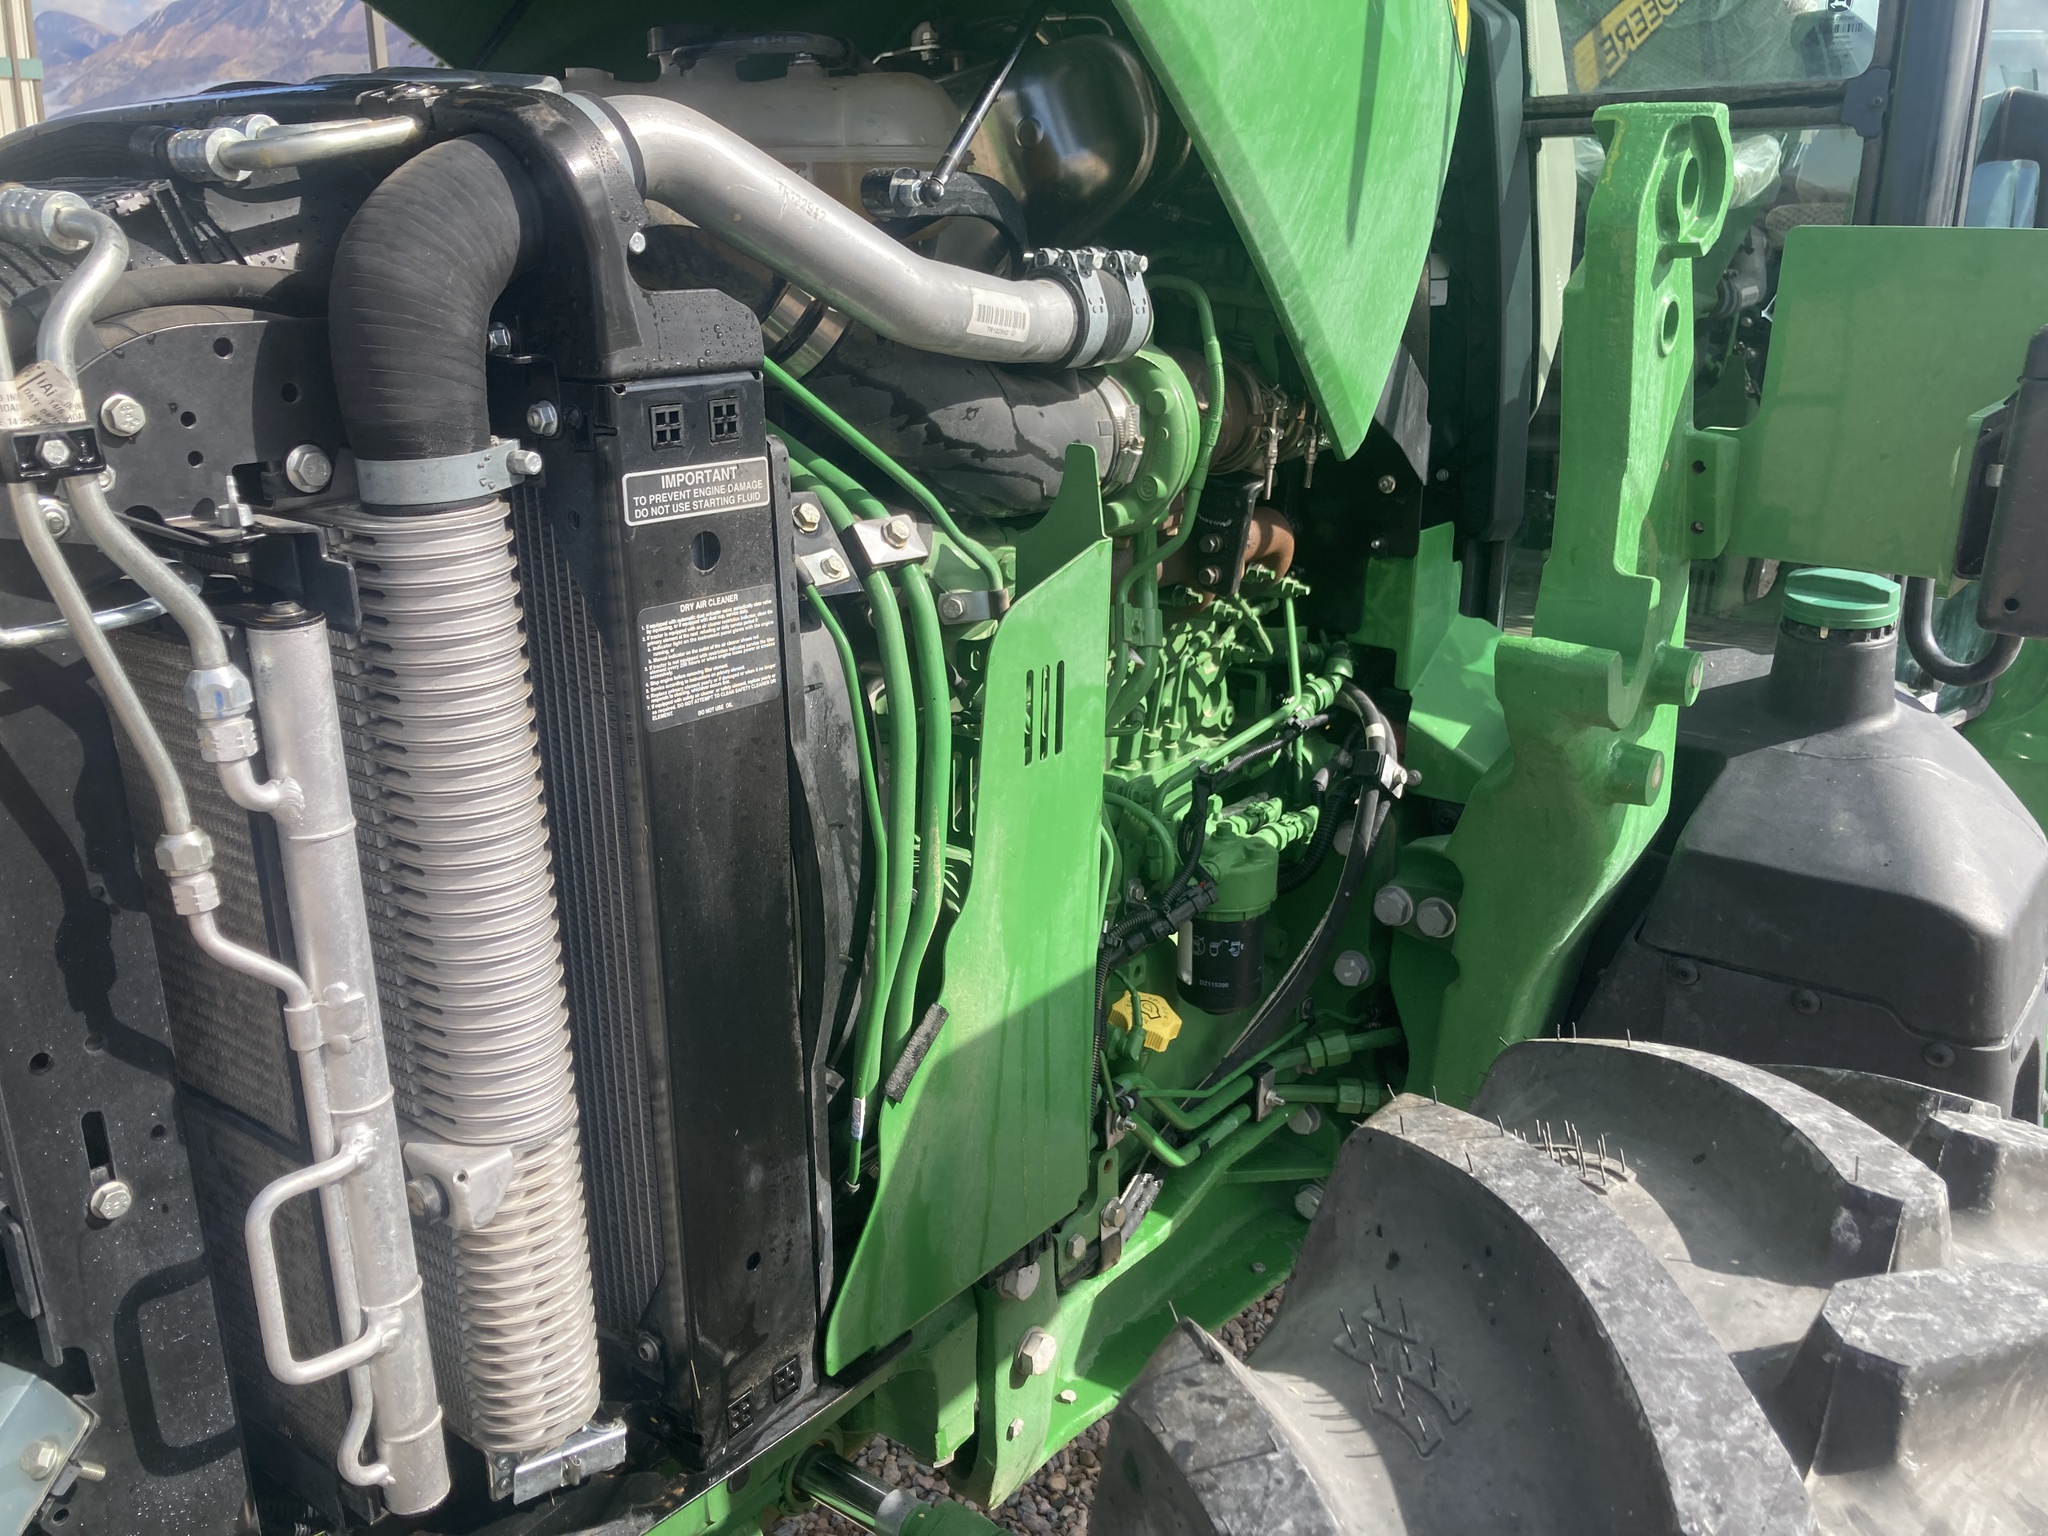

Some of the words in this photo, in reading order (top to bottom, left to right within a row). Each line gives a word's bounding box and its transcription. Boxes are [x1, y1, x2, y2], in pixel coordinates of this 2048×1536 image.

[23, 388, 41, 408] DATE
[661, 466, 737, 489] IMPORTANT
[633, 496, 646, 506] TO
[649, 490, 690, 504] PREVENT
[694, 485, 725, 498] ENGINE
[728, 480, 763, 492] DAMAGE
[635, 508, 648, 519] DO
[651, 504, 670, 516] NOT
[672, 501, 690, 513] USE
[693, 495, 735, 510] STARTING
[737, 491, 760, 503] FLUID
[679, 602, 693, 612] DRY
[695, 600, 706, 609] AIR
[708, 594, 738, 606] CLEANER
[705, 706, 714, 714] NOT
